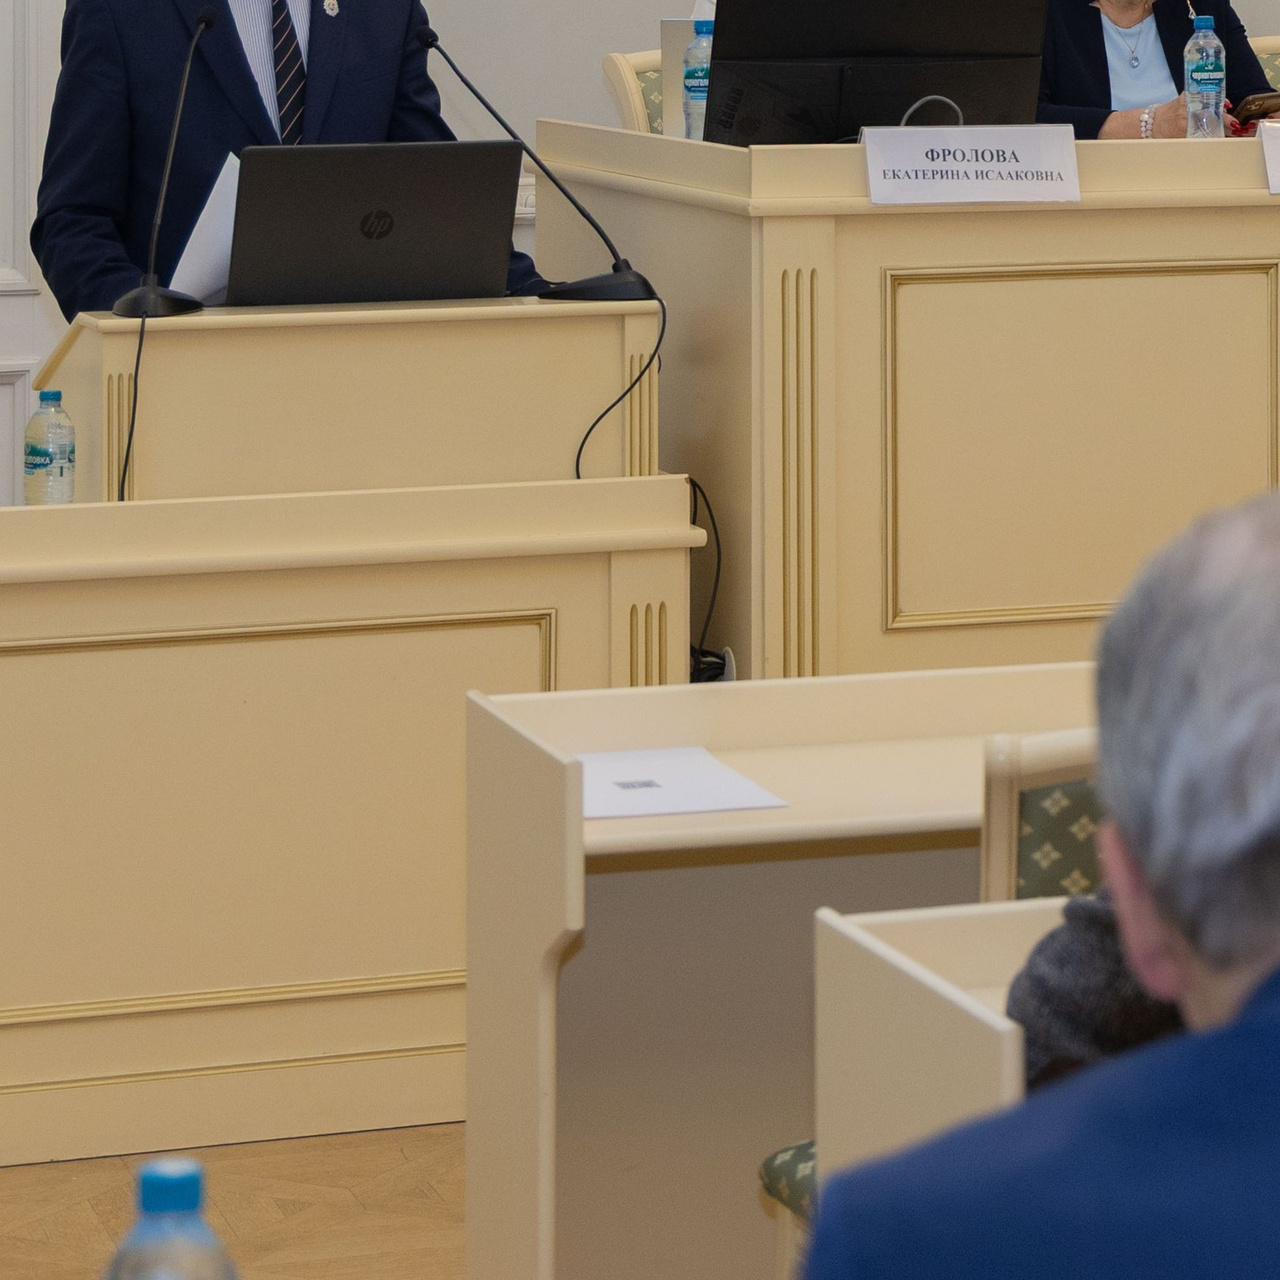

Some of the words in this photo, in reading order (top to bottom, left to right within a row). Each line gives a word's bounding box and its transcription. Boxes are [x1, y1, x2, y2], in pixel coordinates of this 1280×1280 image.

[925, 148, 1020, 163] ФРОЛОВА
[882, 169, 970, 180] ЕКАТЕРИНА
[975, 169, 1064, 182] ИСААКОВНА
